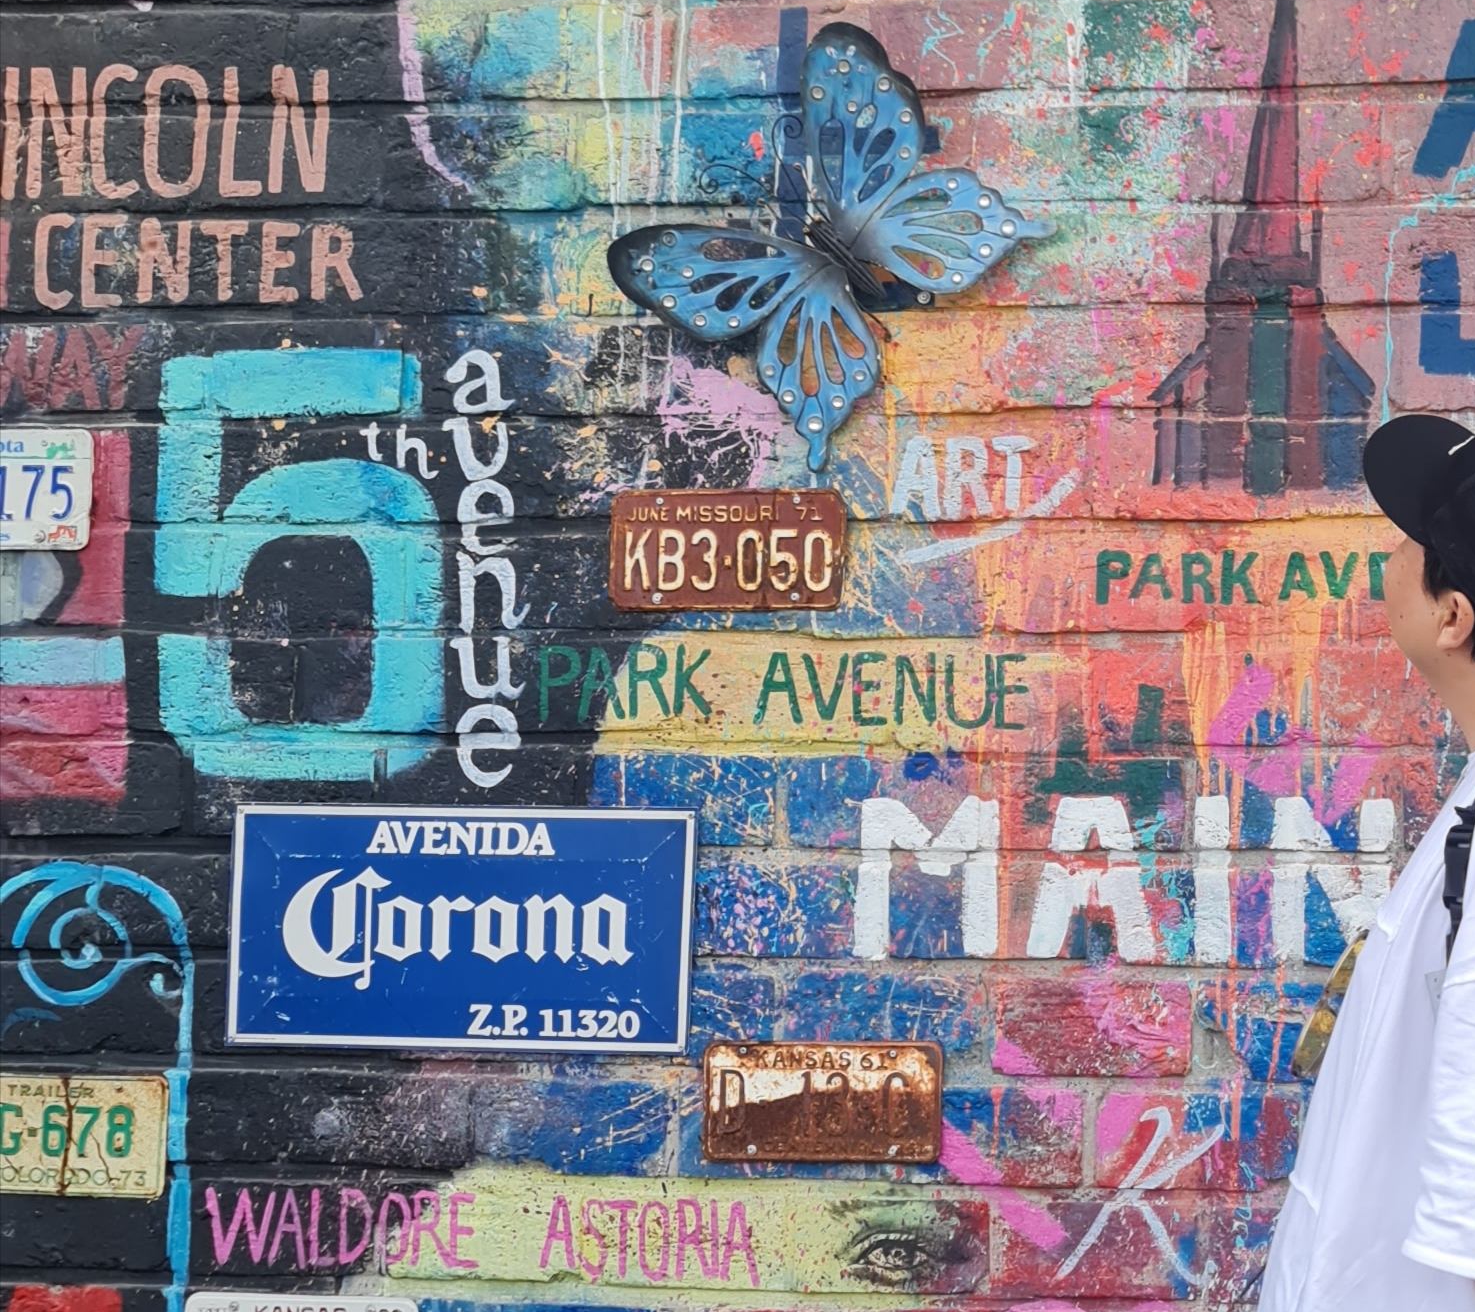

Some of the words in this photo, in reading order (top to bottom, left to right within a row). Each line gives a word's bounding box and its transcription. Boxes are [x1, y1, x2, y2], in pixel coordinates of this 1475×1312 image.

[34, 213, 364, 310] CENTER
[892, 435, 1034, 518] ART
[627, 507, 669, 522] JUNE
[676, 506, 780, 522] MISSOURI
[1095, 549, 1263, 605] PARK
[537, 645, 711, 723] PARK
[753, 649, 1029, 731] AVENUE
[367, 821, 555, 857] AVENIDA
[283, 866, 634, 989] Corona
[468, 1004, 530, 1039] Z.P.
[539, 1008, 640, 1038] 11320
[756, 1049, 851, 1070] KANSAS
[8, 1084, 94, 1099] TRAILER
[539, 1195, 760, 1287] ASTORIA
